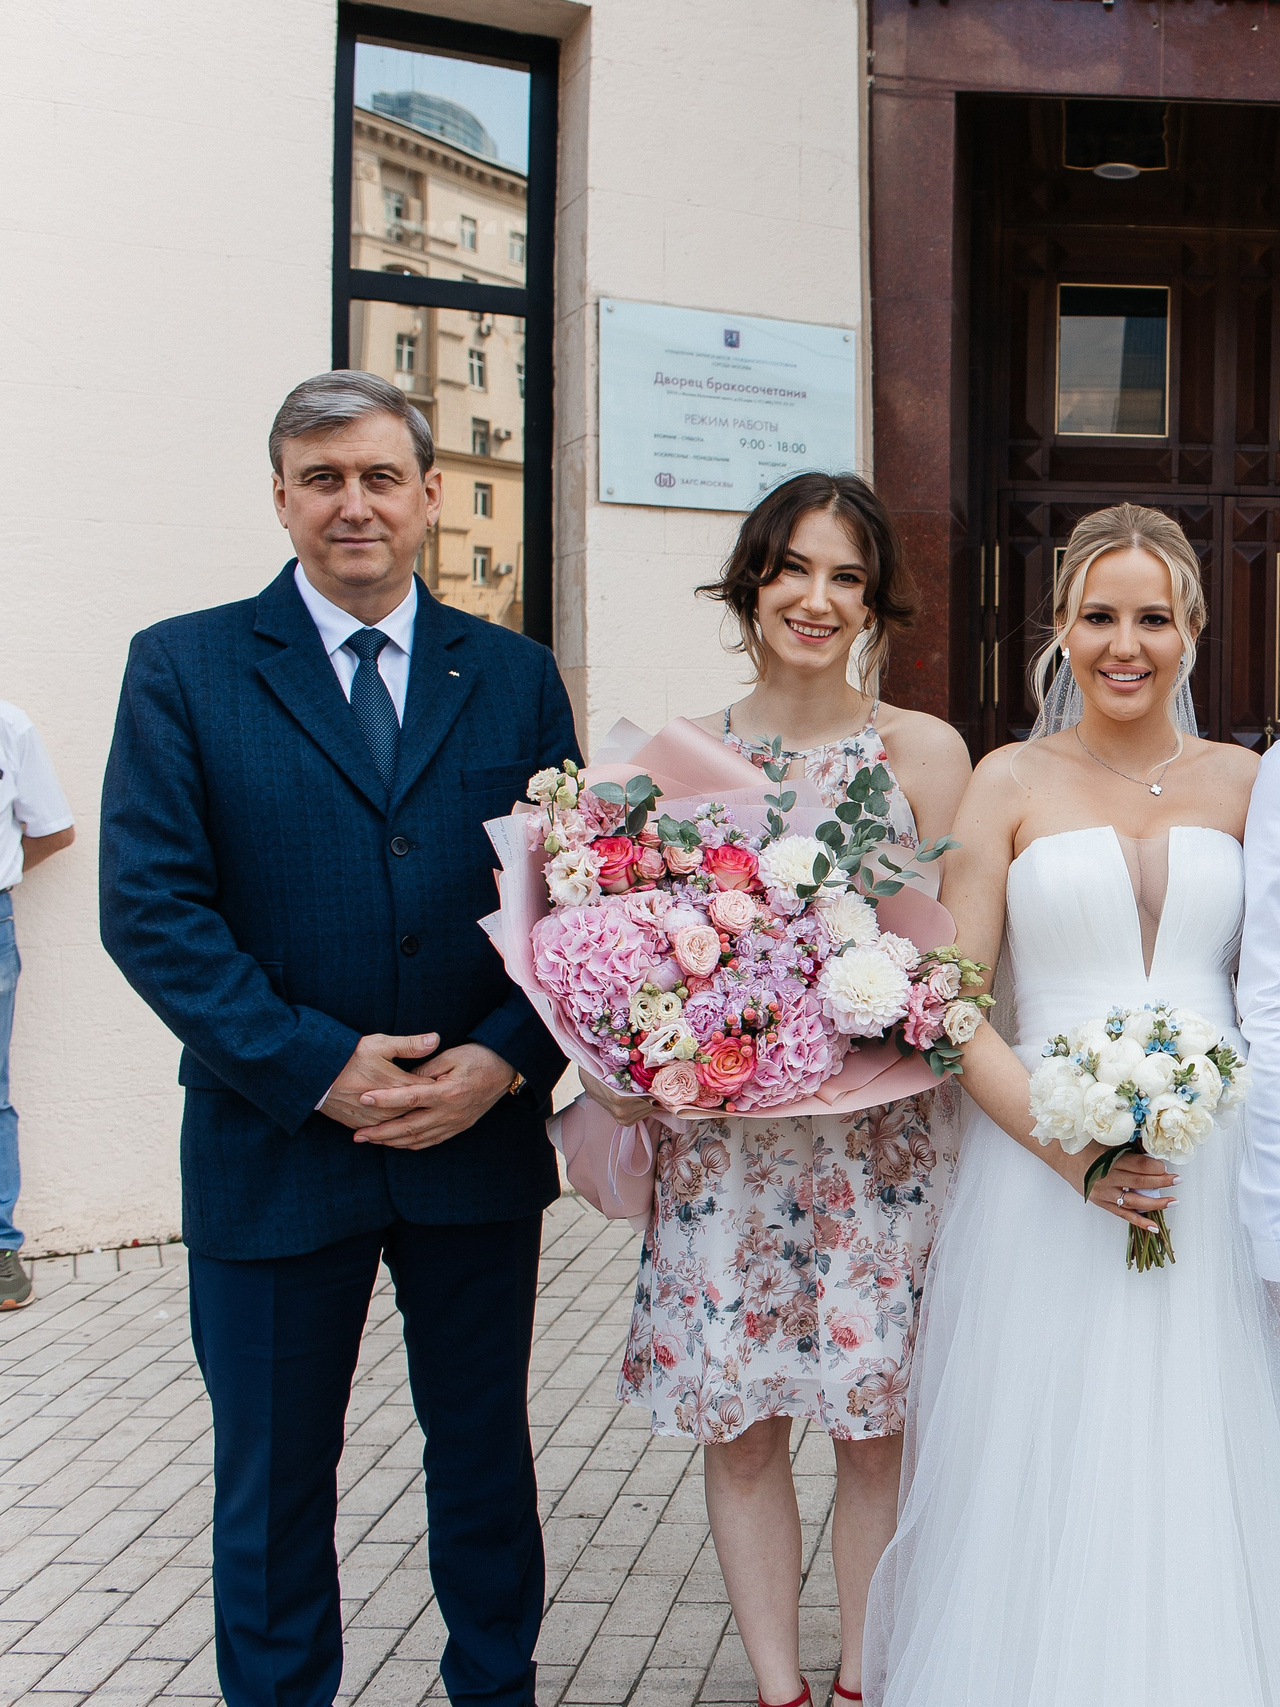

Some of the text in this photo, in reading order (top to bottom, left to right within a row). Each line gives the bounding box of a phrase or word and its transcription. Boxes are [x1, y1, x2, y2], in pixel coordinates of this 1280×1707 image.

[653, 371, 703, 389] Дворец
[706, 377, 807, 399] бракосочетания
[684, 414, 779, 433] РЕЖИМ РАБОТЫ
[739, 438, 765, 451] 9:00
[777, 441, 806, 454] 18:00
